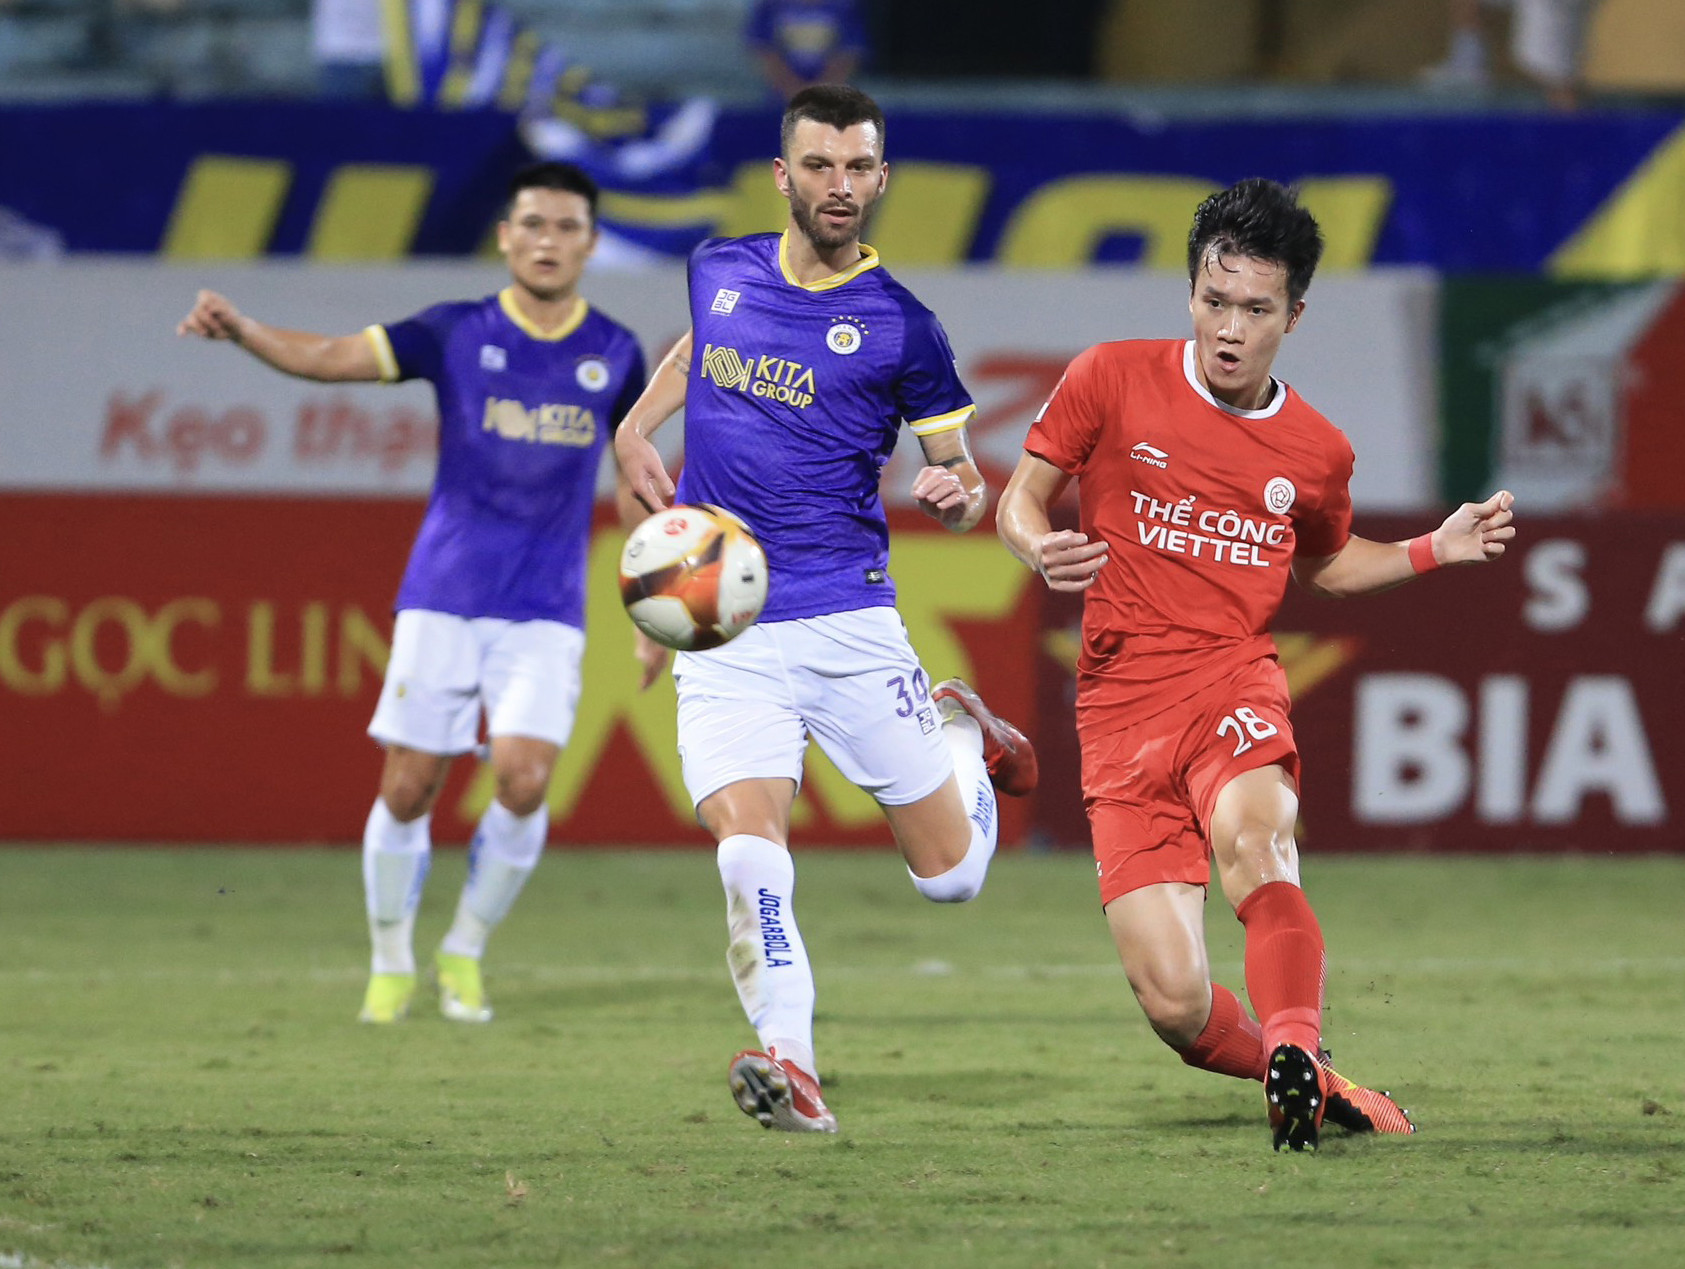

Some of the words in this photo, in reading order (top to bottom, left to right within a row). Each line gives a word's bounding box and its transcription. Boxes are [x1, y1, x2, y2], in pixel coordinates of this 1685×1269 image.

[752, 380, 814, 409] GROUP
[755, 354, 816, 395] KITA
[1130, 451, 1168, 470] LI-NING
[1130, 490, 1197, 526] THỂ
[1198, 509, 1286, 546] CÔNG
[1137, 520, 1270, 567] VIETTEL
[886, 666, 928, 718] 30
[1216, 706, 1278, 758] 28
[1353, 671, 1669, 826] BIA
[757, 887, 793, 968] JOGARBOLA
